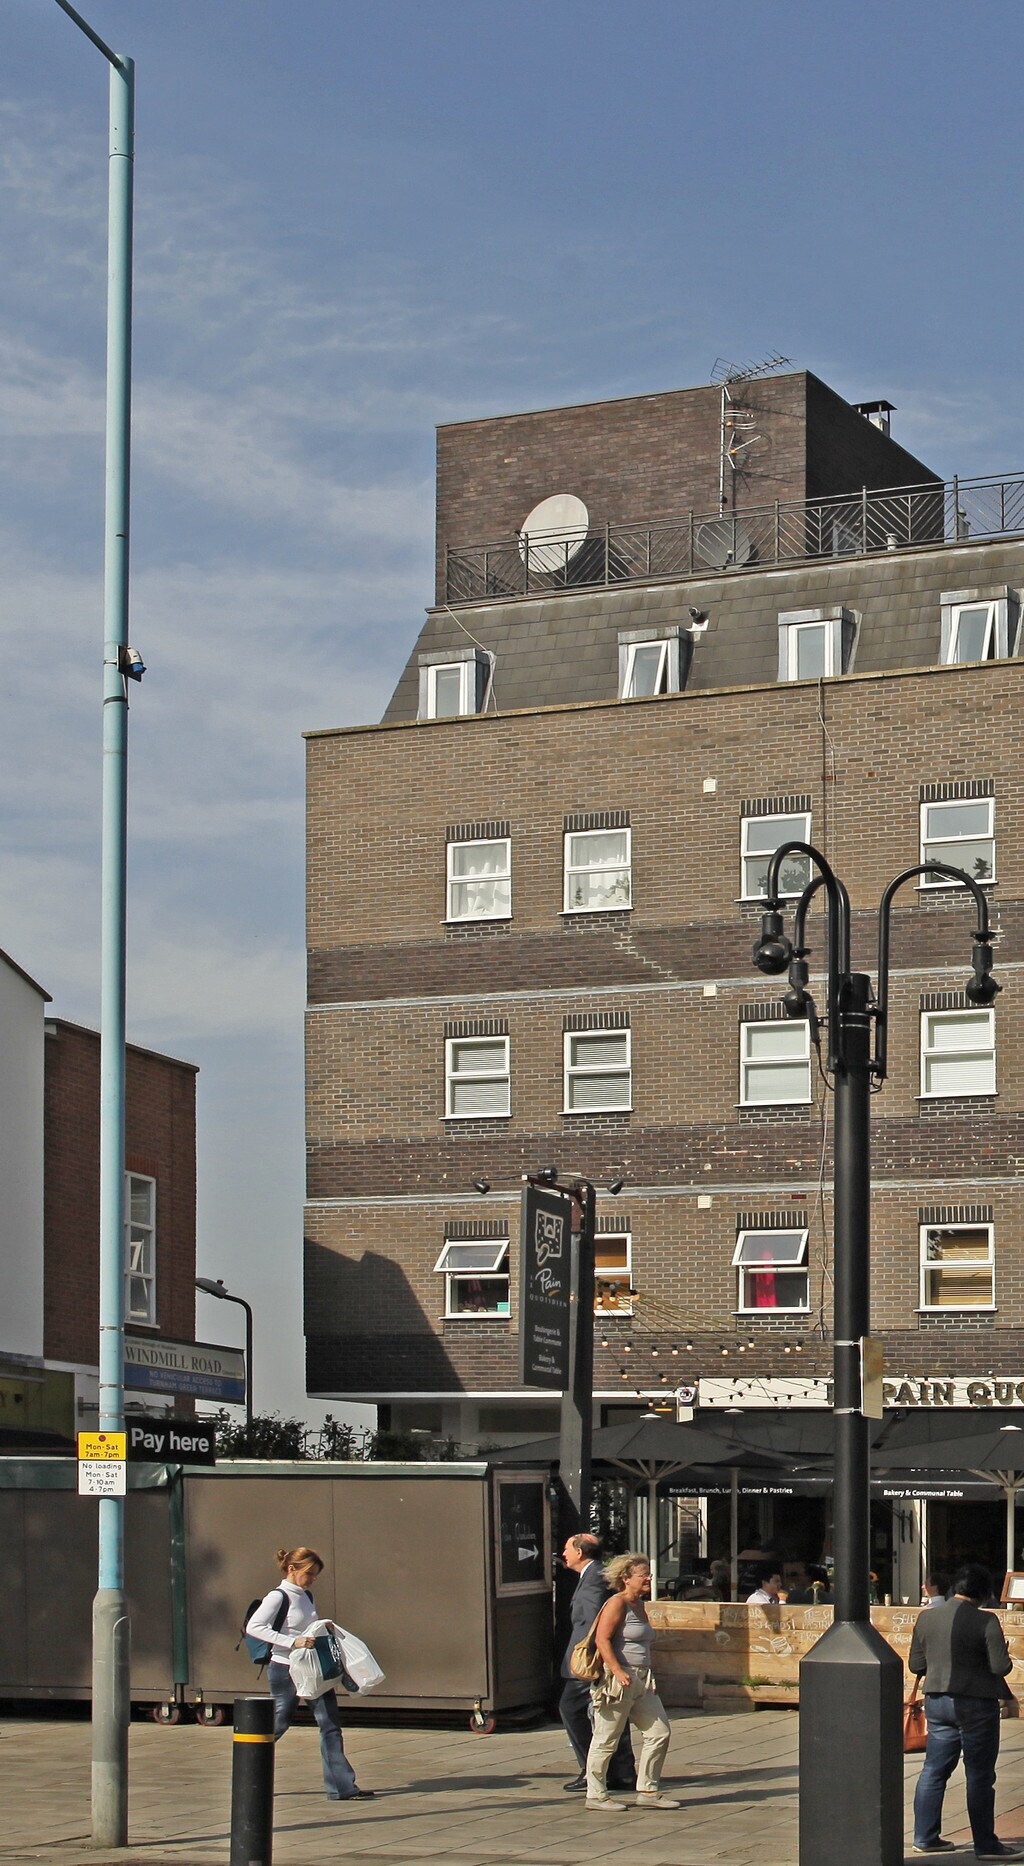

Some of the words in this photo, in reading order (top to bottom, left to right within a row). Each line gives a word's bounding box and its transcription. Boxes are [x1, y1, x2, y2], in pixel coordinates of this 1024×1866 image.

[535, 1268, 561, 1293] Pain
[125, 1346, 188, 1369] WINDMILL
[191, 1357, 222, 1374] ROAD
[882, 1382, 956, 1406] PAIN
[131, 1427, 165, 1453] Pay
[169, 1430, 210, 1453] here
[95, 1462, 122, 1470] loading
[883, 1489, 905, 1498] Bakery
